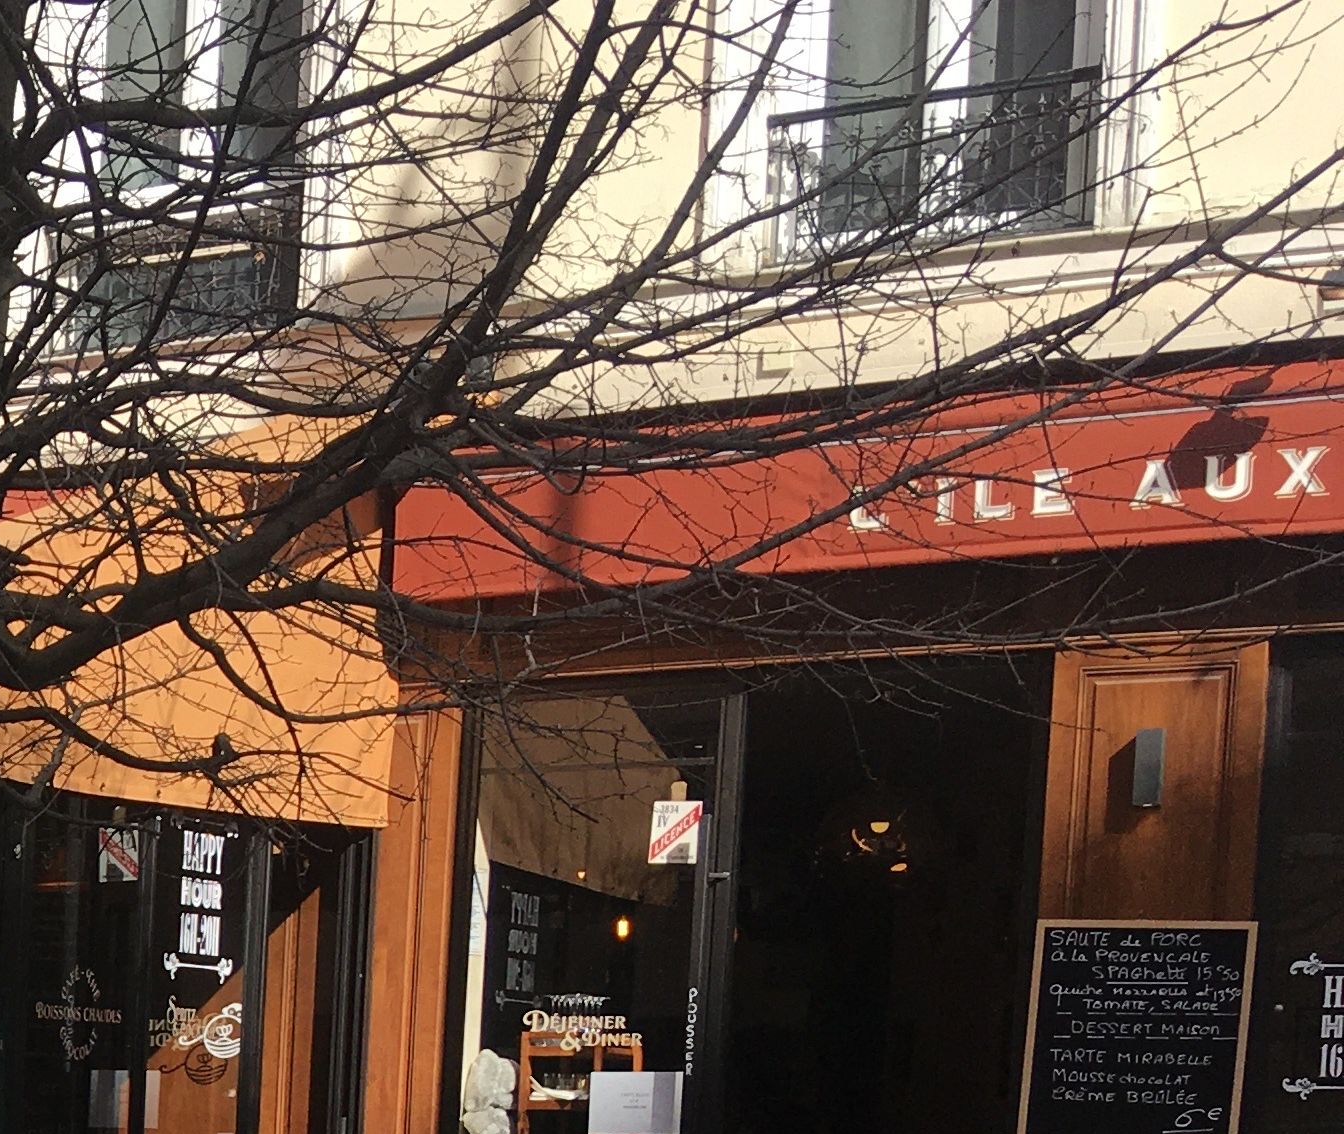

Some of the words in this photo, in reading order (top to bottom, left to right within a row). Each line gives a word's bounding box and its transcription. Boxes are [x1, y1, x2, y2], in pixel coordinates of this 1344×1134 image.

[1131, 446, 1333, 509] AUX
[183, 830, 225, 875] HAPPY
[653, 811, 696, 855] LICENCE
[181, 876, 223, 910] HOUR
[523, 1010, 626, 1033] DÉJEUNER
[685, 987, 699, 1076] POUSSER
[1071, 1020, 1153, 1034] DESSERT
[1050, 1048, 1106, 1064] TARTE
